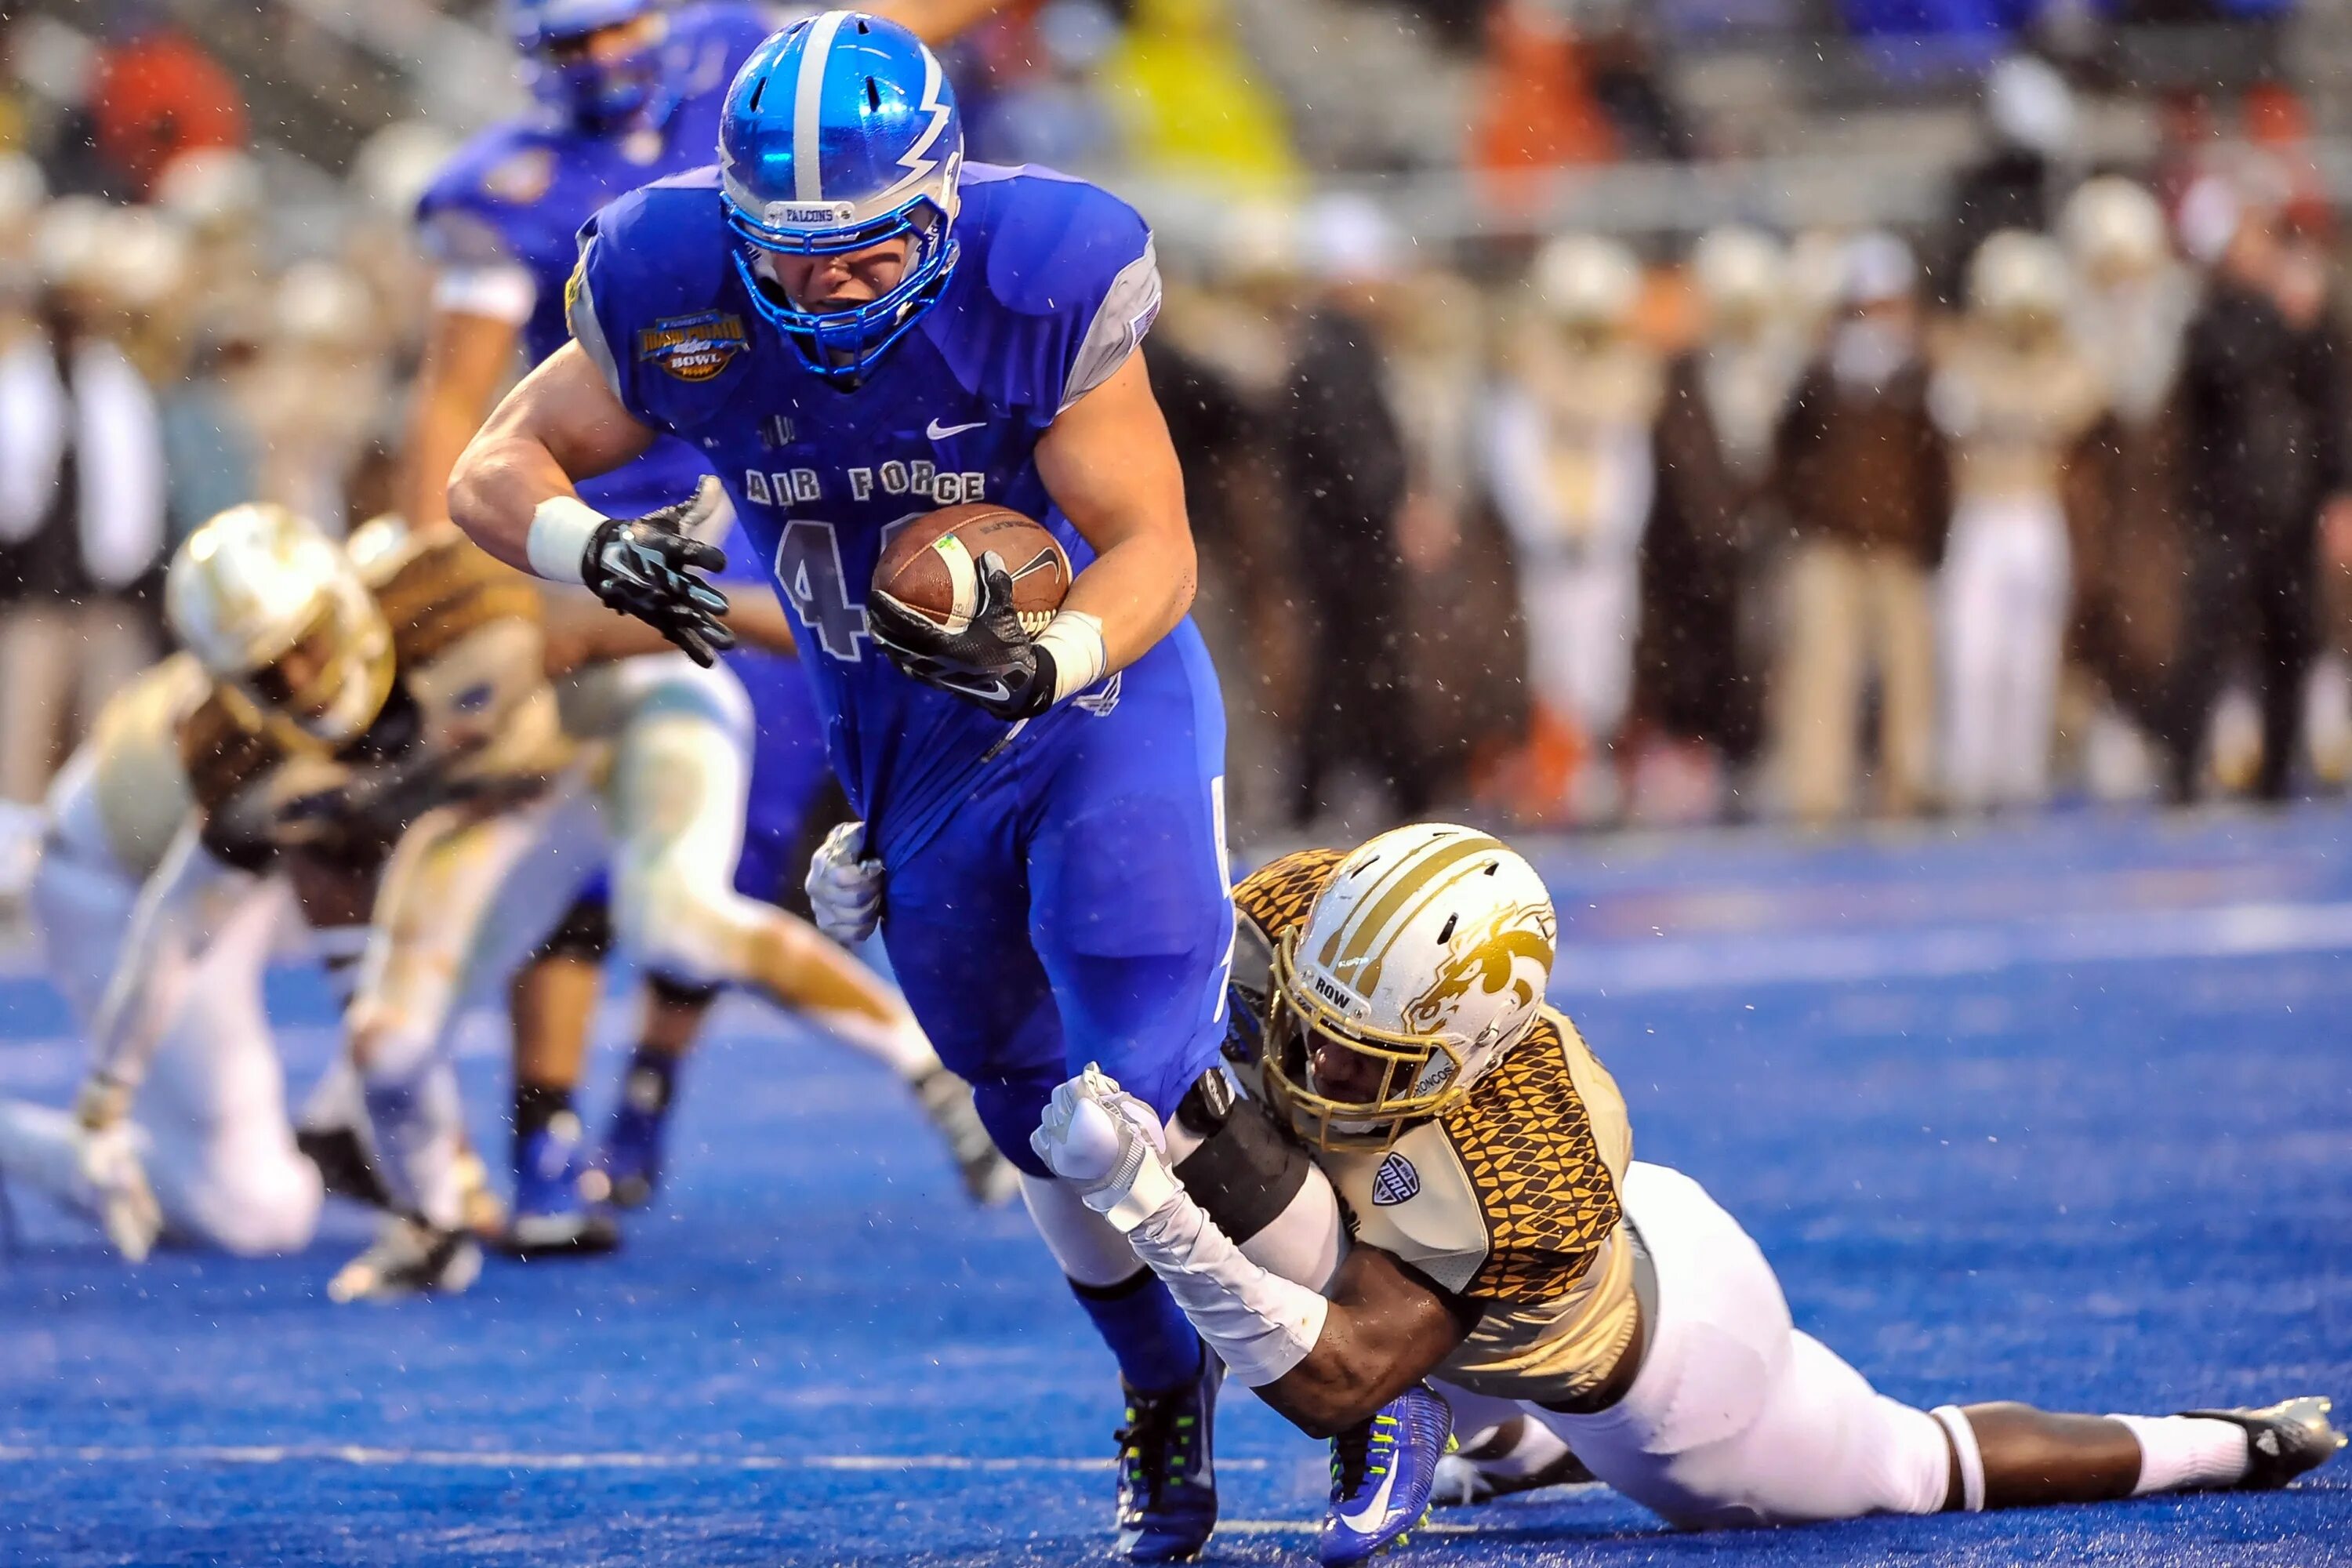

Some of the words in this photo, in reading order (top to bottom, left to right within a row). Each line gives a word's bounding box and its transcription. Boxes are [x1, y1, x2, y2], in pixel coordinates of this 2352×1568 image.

[786, 209, 833, 223] FALCONS
[671, 353, 722, 368] BOWL
[746, 469, 821, 506] AIR
[848, 460, 985, 504] FORCE
[1316, 977, 1350, 1009] ROW
[1412, 1066, 1453, 1098] RONCOS
[1379, 1162, 1411, 1202] MAC
